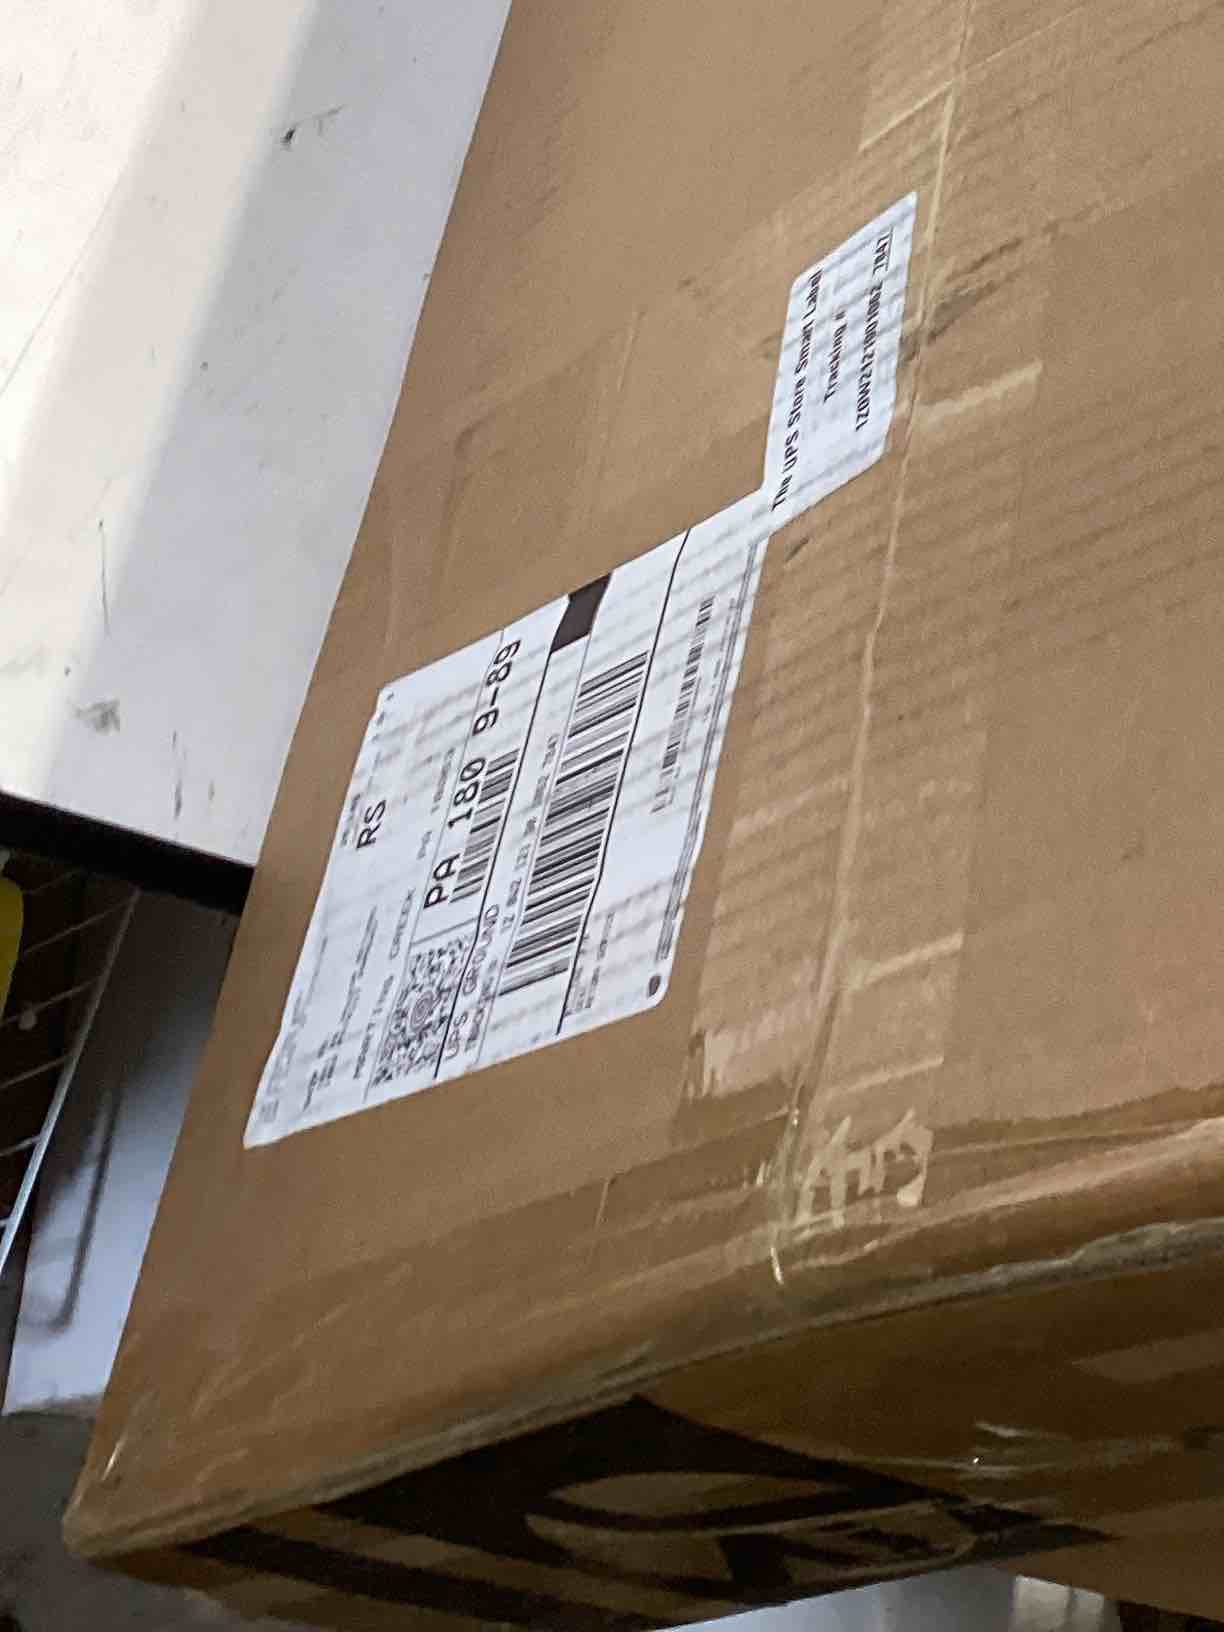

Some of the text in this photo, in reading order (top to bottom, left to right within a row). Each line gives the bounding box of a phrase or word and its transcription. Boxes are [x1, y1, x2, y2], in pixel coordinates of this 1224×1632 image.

[802, 268, 823, 320] Label
[795, 321, 815, 377] Smart
[823, 321, 848, 404] Tracking
[787, 376, 806, 428] Store
[781, 429, 800, 474] UPS
[422, 635, 523, 909] PA 180 9-89
[354, 795, 388, 852] RS
[443, 902, 502, 1062] UPS GROUND
